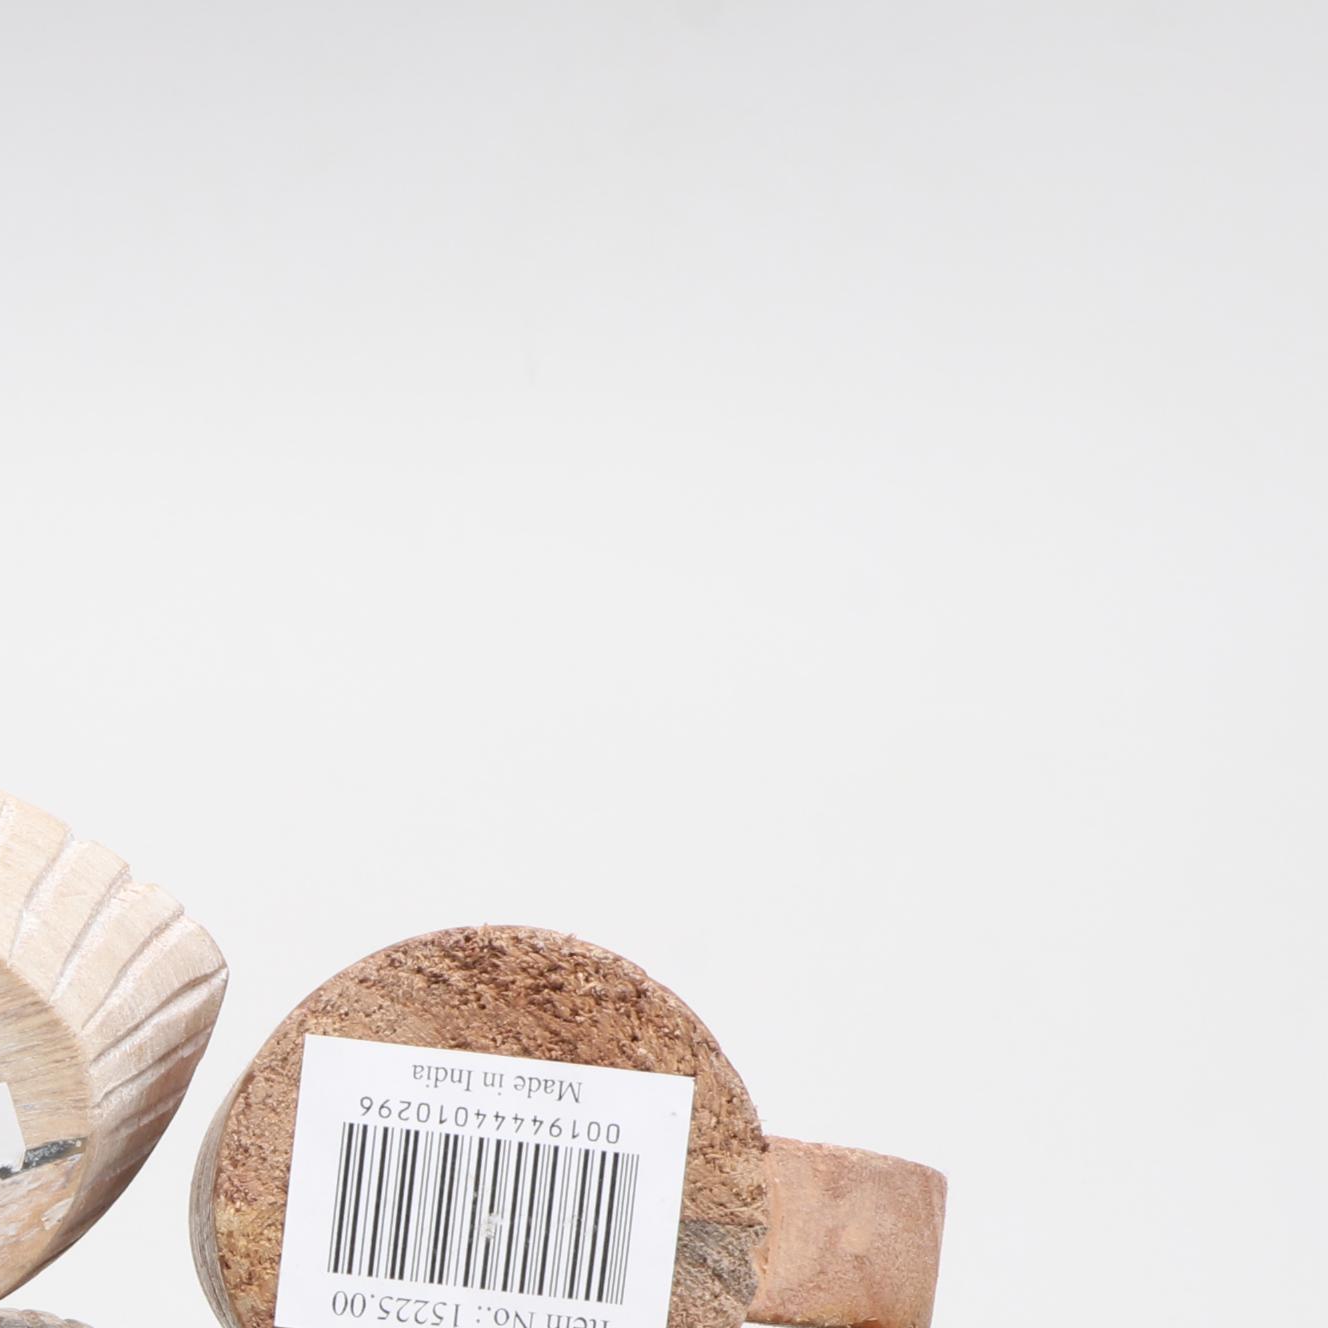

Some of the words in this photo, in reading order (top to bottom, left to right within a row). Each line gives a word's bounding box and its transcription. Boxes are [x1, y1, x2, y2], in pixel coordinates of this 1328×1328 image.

[412, 1064, 473, 1092] India
[483, 1071, 504, 1096] in
[513, 1075, 582, 1104] Made
[359, 1095, 621, 1145] 00194444010296
[331, 1290, 460, 1328] 15225.00
